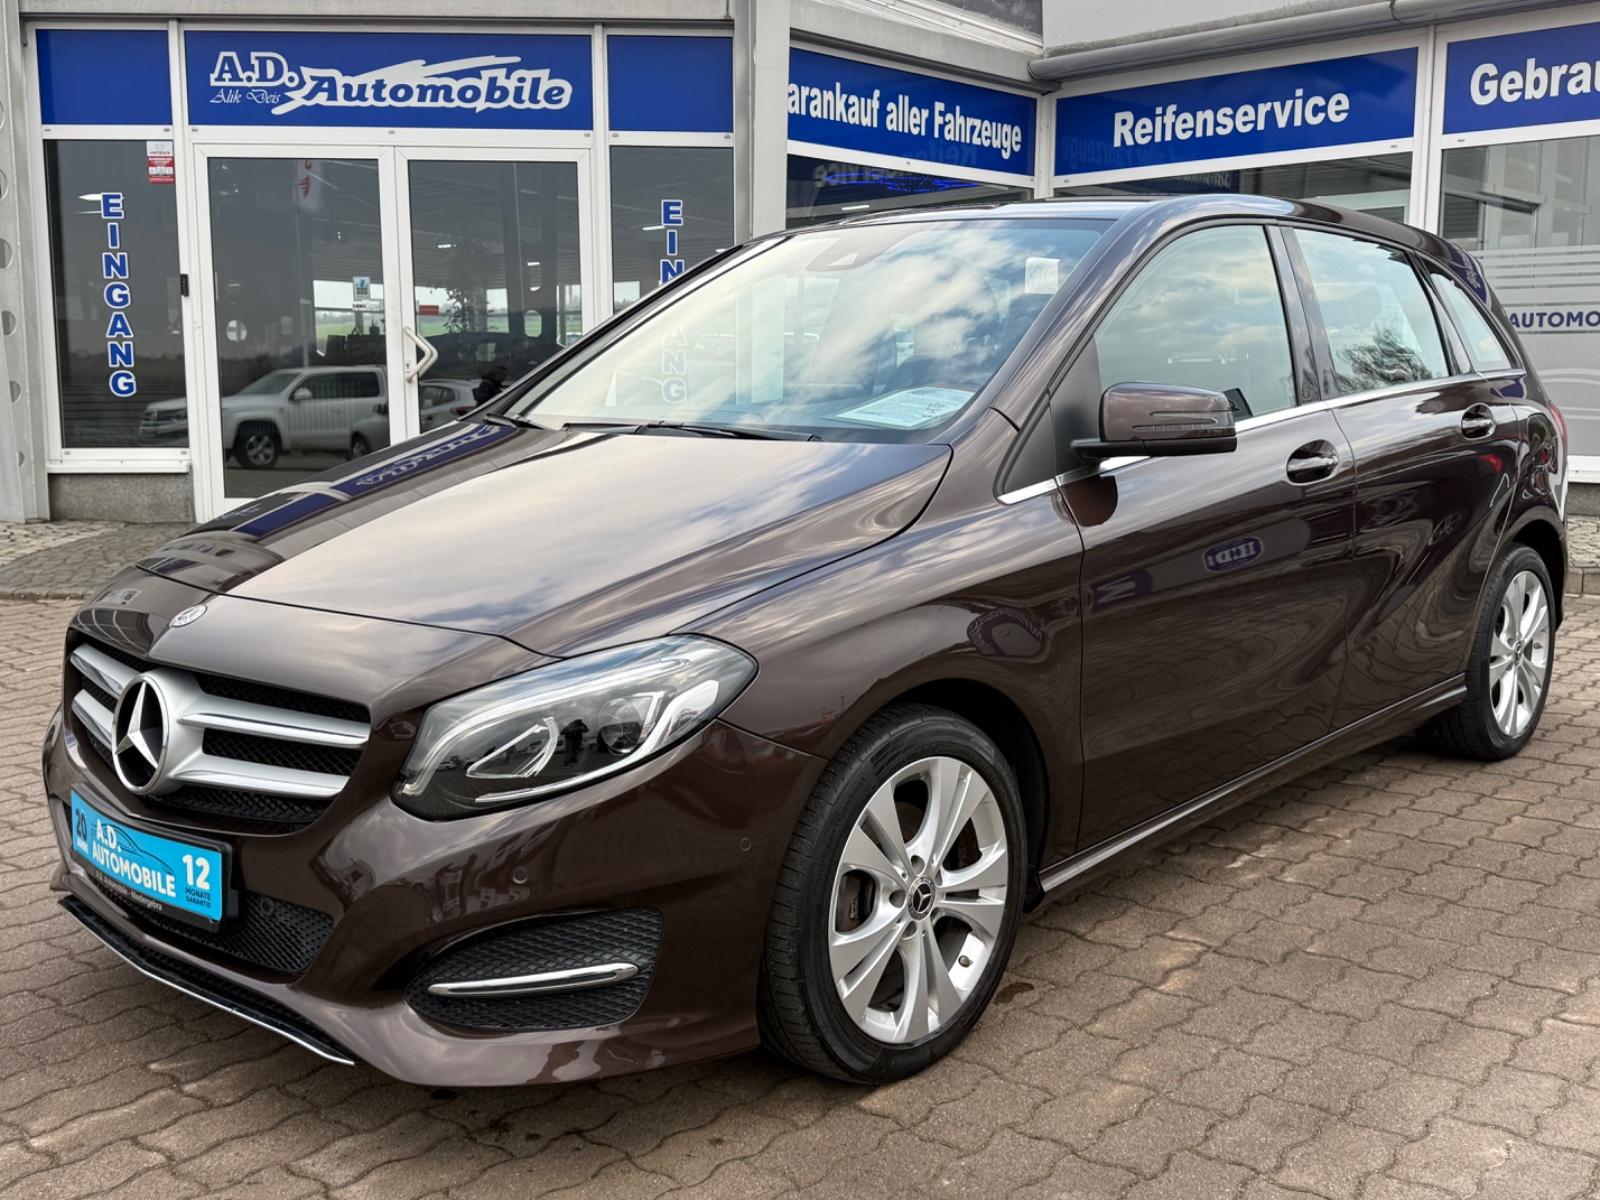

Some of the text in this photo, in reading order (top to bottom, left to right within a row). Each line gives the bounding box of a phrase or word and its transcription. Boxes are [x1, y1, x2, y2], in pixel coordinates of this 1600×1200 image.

[210, 51, 572, 111] A.D. Automobile
[210, 88, 282, 104] Alik Deis
[788, 82, 880, 128] arankauf
[886, 94, 930, 136] aller
[933, 101, 1022, 159] Fahrzeuge
[1113, 88, 1350, 147] Reifenservice
[101, 192, 137, 397] EINGANG
[660, 200, 688, 402] EINANG
[1509, 310, 1600, 328] AUTOMO
[75, 808, 87, 841] 20
[96, 819, 122, 853] A.D.
[92, 842, 176, 898] AUTOMOBILE
[182, 854, 210, 891] 12
[185, 886, 211, 901] MONATE
